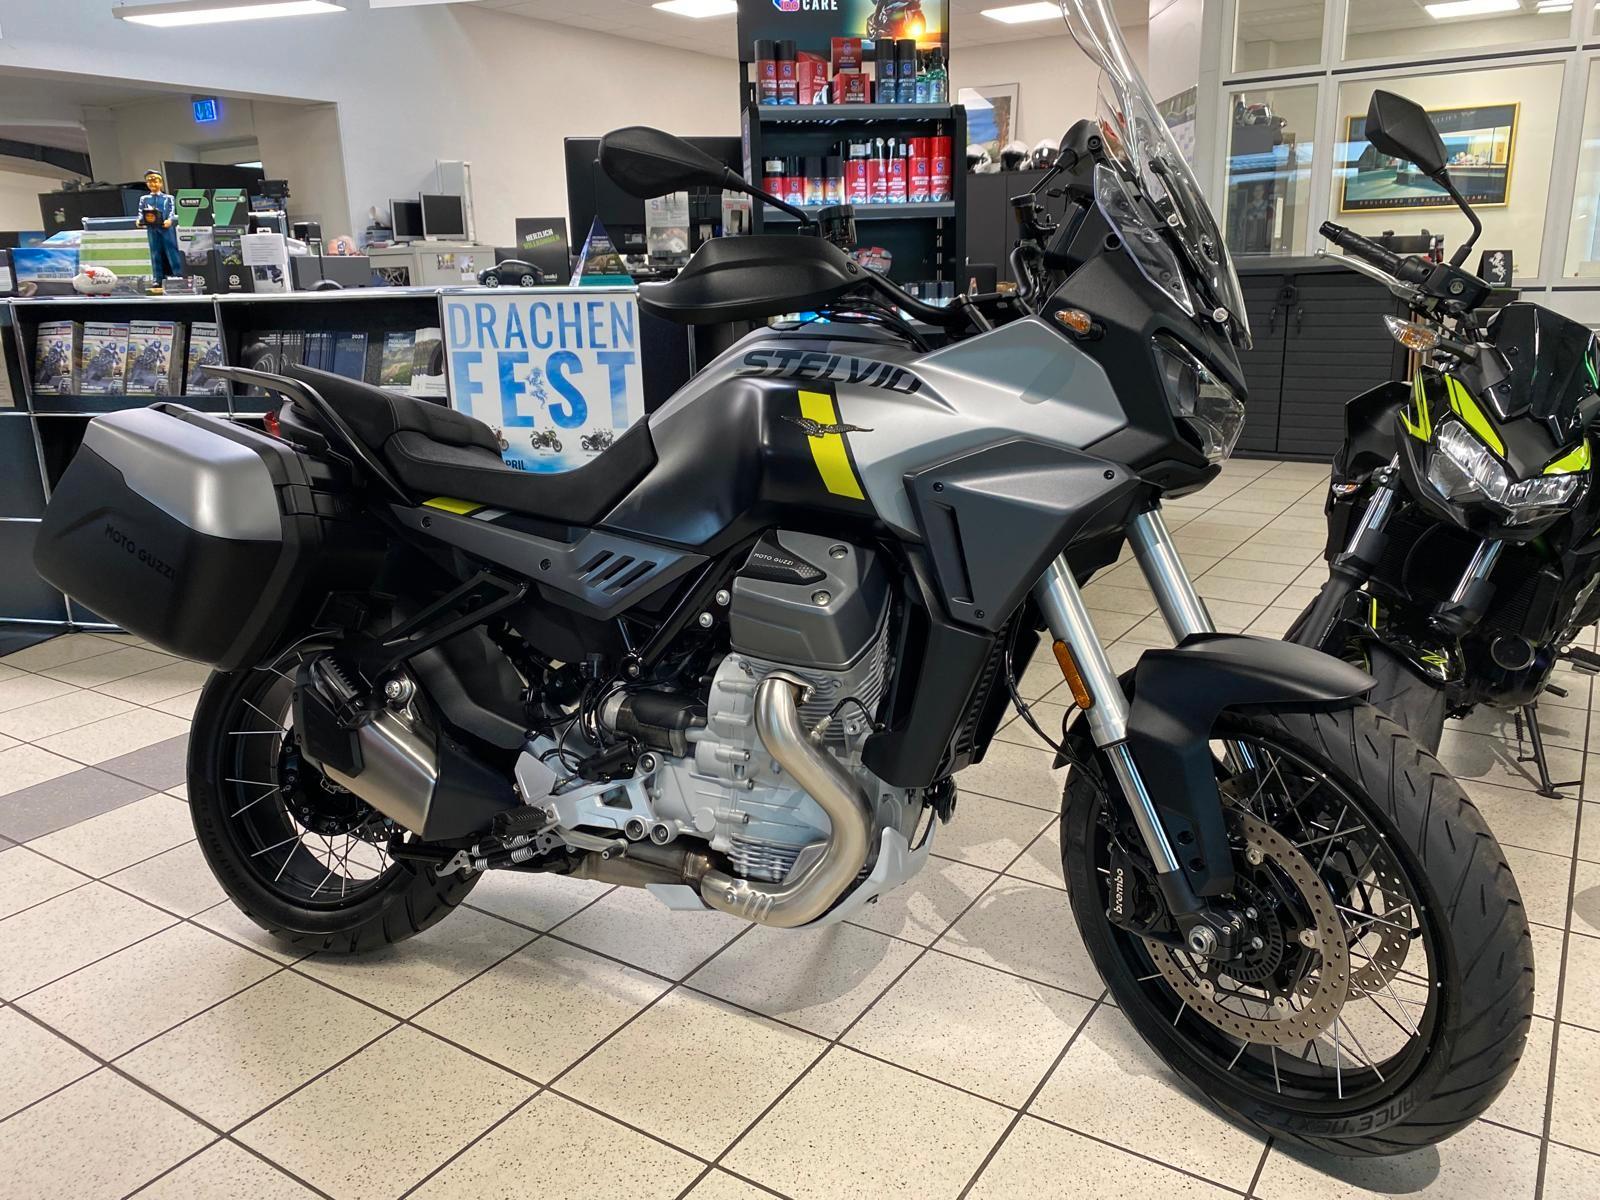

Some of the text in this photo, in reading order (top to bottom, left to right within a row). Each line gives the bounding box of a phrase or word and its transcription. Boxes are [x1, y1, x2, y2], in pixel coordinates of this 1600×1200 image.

[802, 0, 838, 11] CARE
[525, 228, 554, 242] HERZLICH
[447, 300, 635, 350] DRACHEN
[451, 351, 636, 429] FEST
[743, 349, 924, 395] STELVIO
[505, 459, 527, 471] PRIL
[104, 522, 176, 582] MOTO GUZZI
[754, 553, 793, 566] MOTO GUZZI
[1113, 867, 1125, 915] brembo
